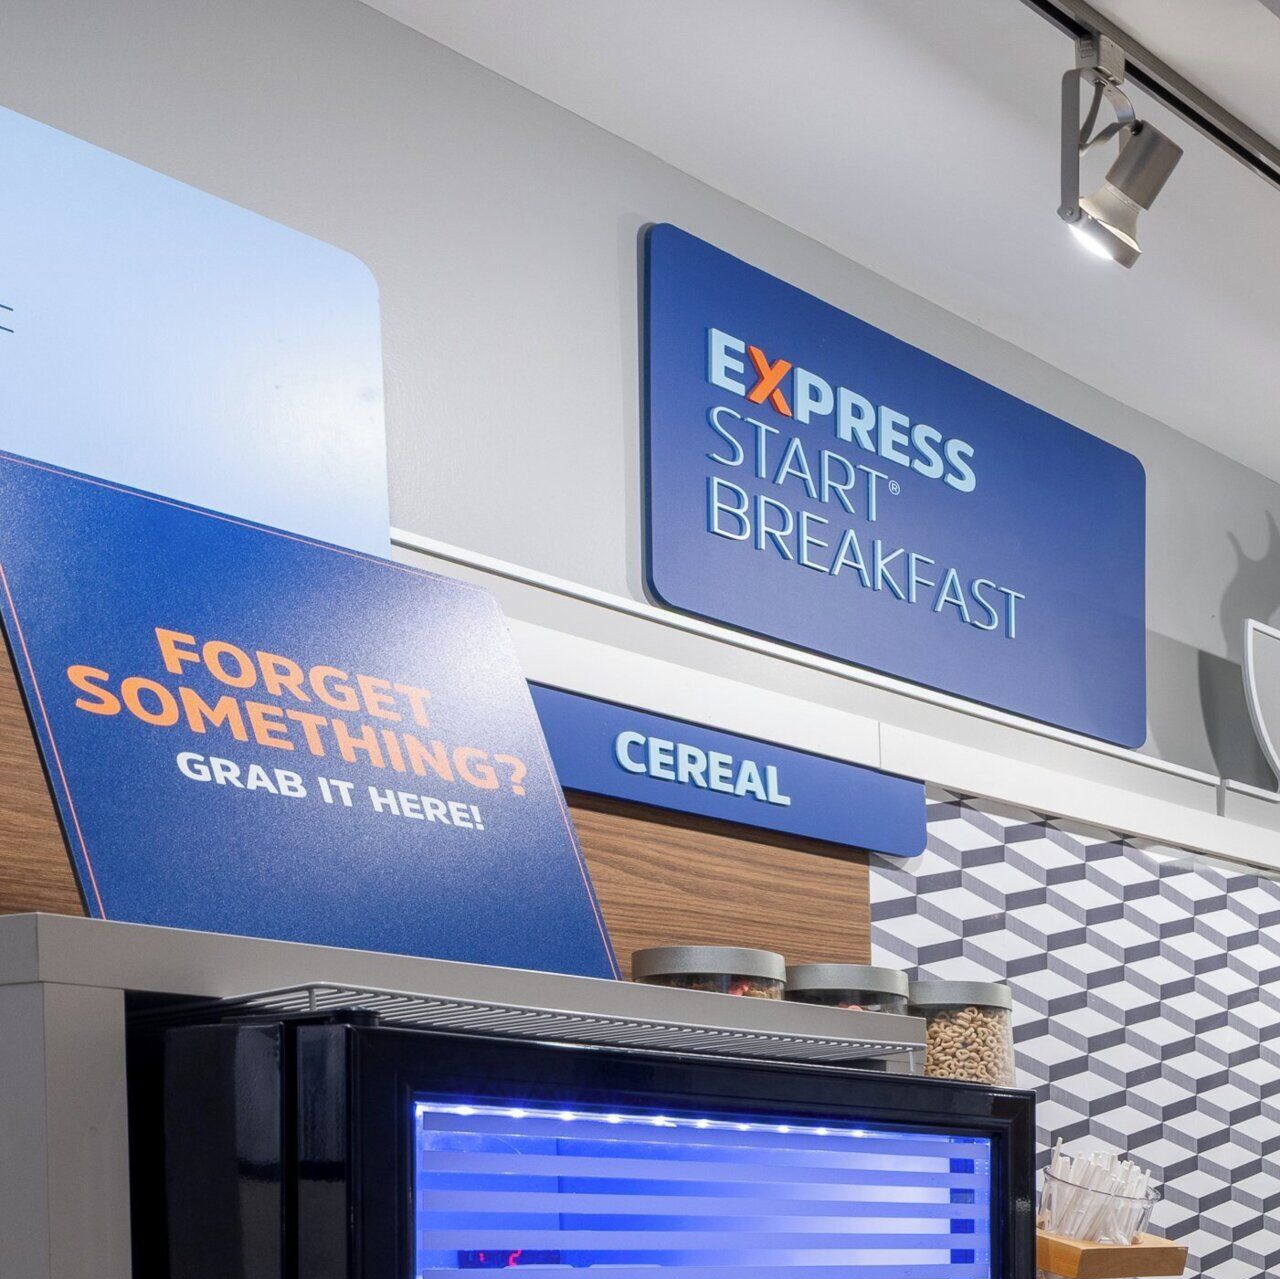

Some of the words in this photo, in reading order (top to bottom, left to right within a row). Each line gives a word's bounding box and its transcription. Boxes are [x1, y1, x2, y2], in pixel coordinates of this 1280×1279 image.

[708, 327, 977, 493] EXPRESS
[707, 476, 1026, 639] BREAKFAST
[66, 664, 528, 796] SOMETHING?
[154, 626, 432, 729] FORGET
[176, 751, 307, 799] GRAB
[317, 776, 355, 808] IT
[370, 786, 485, 831] HERE!
[615, 731, 791, 806] CEREAL
